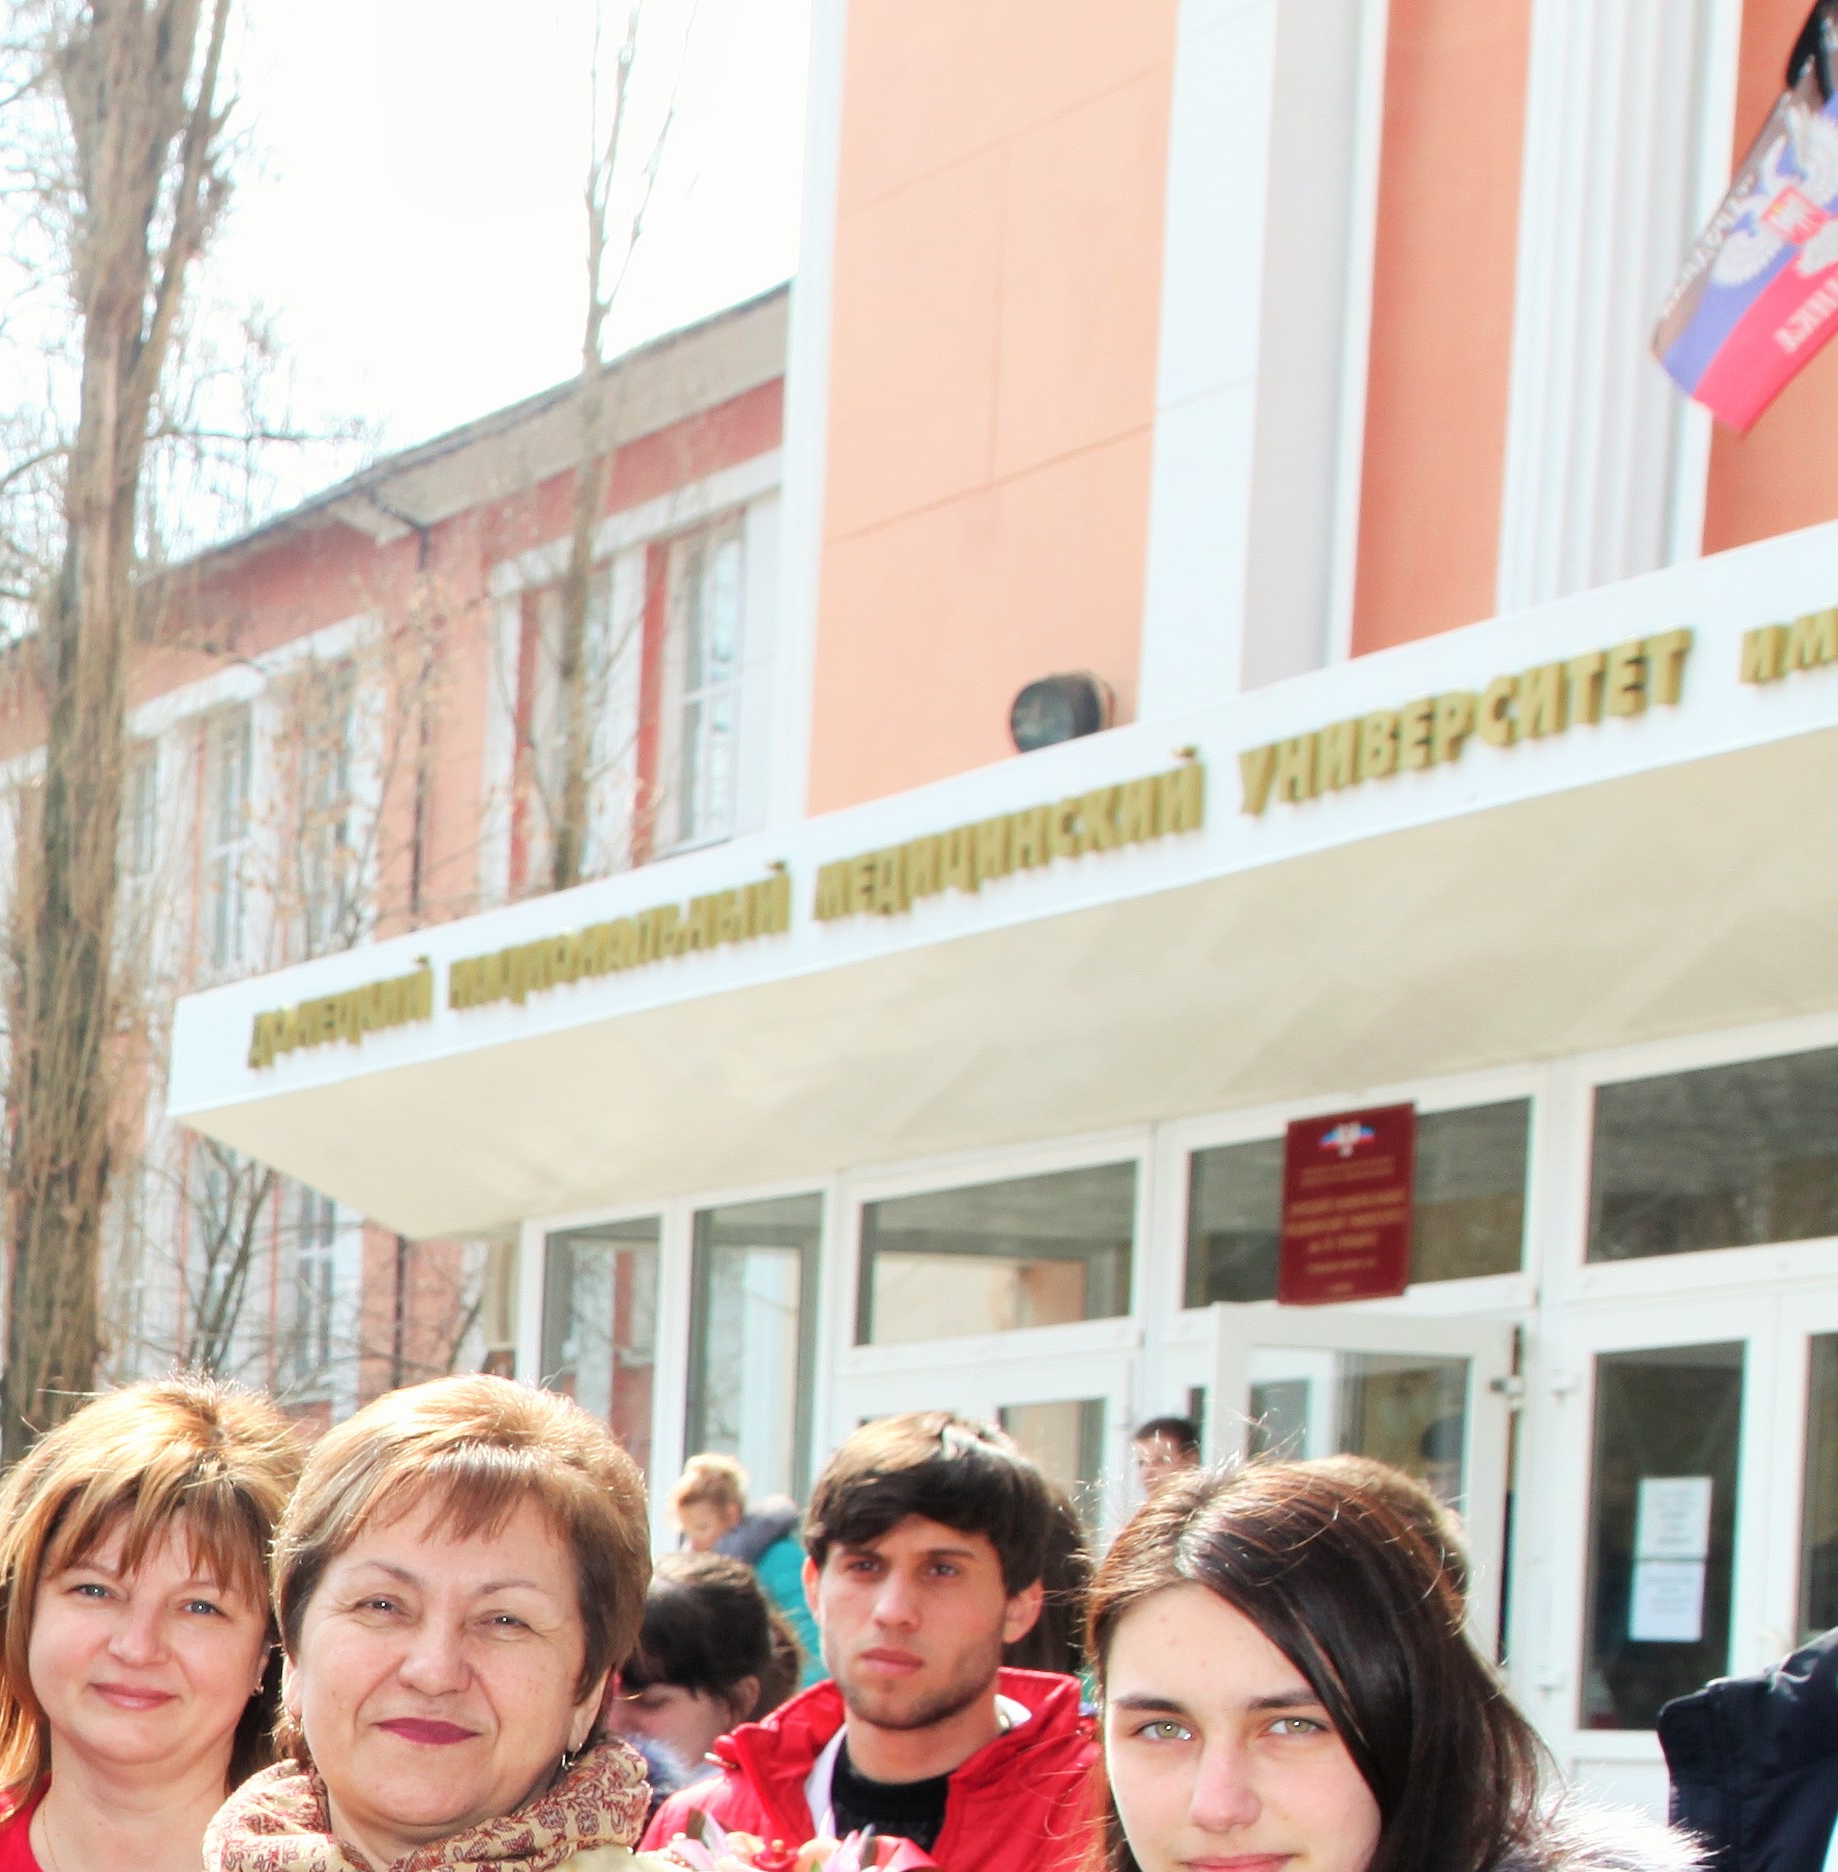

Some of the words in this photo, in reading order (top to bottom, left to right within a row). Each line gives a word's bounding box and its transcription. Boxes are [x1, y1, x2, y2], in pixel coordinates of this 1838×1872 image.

[248, 955, 433, 1070] ДОНЕЦКИЙ
[449, 861, 791, 1010] НАЦИОНАЛЬНЫЙ
[813, 745, 1205, 921] МЕДИЦИНСКИЙ
[1238, 626, 1693, 815] УНИВЕРСИТЕТ
